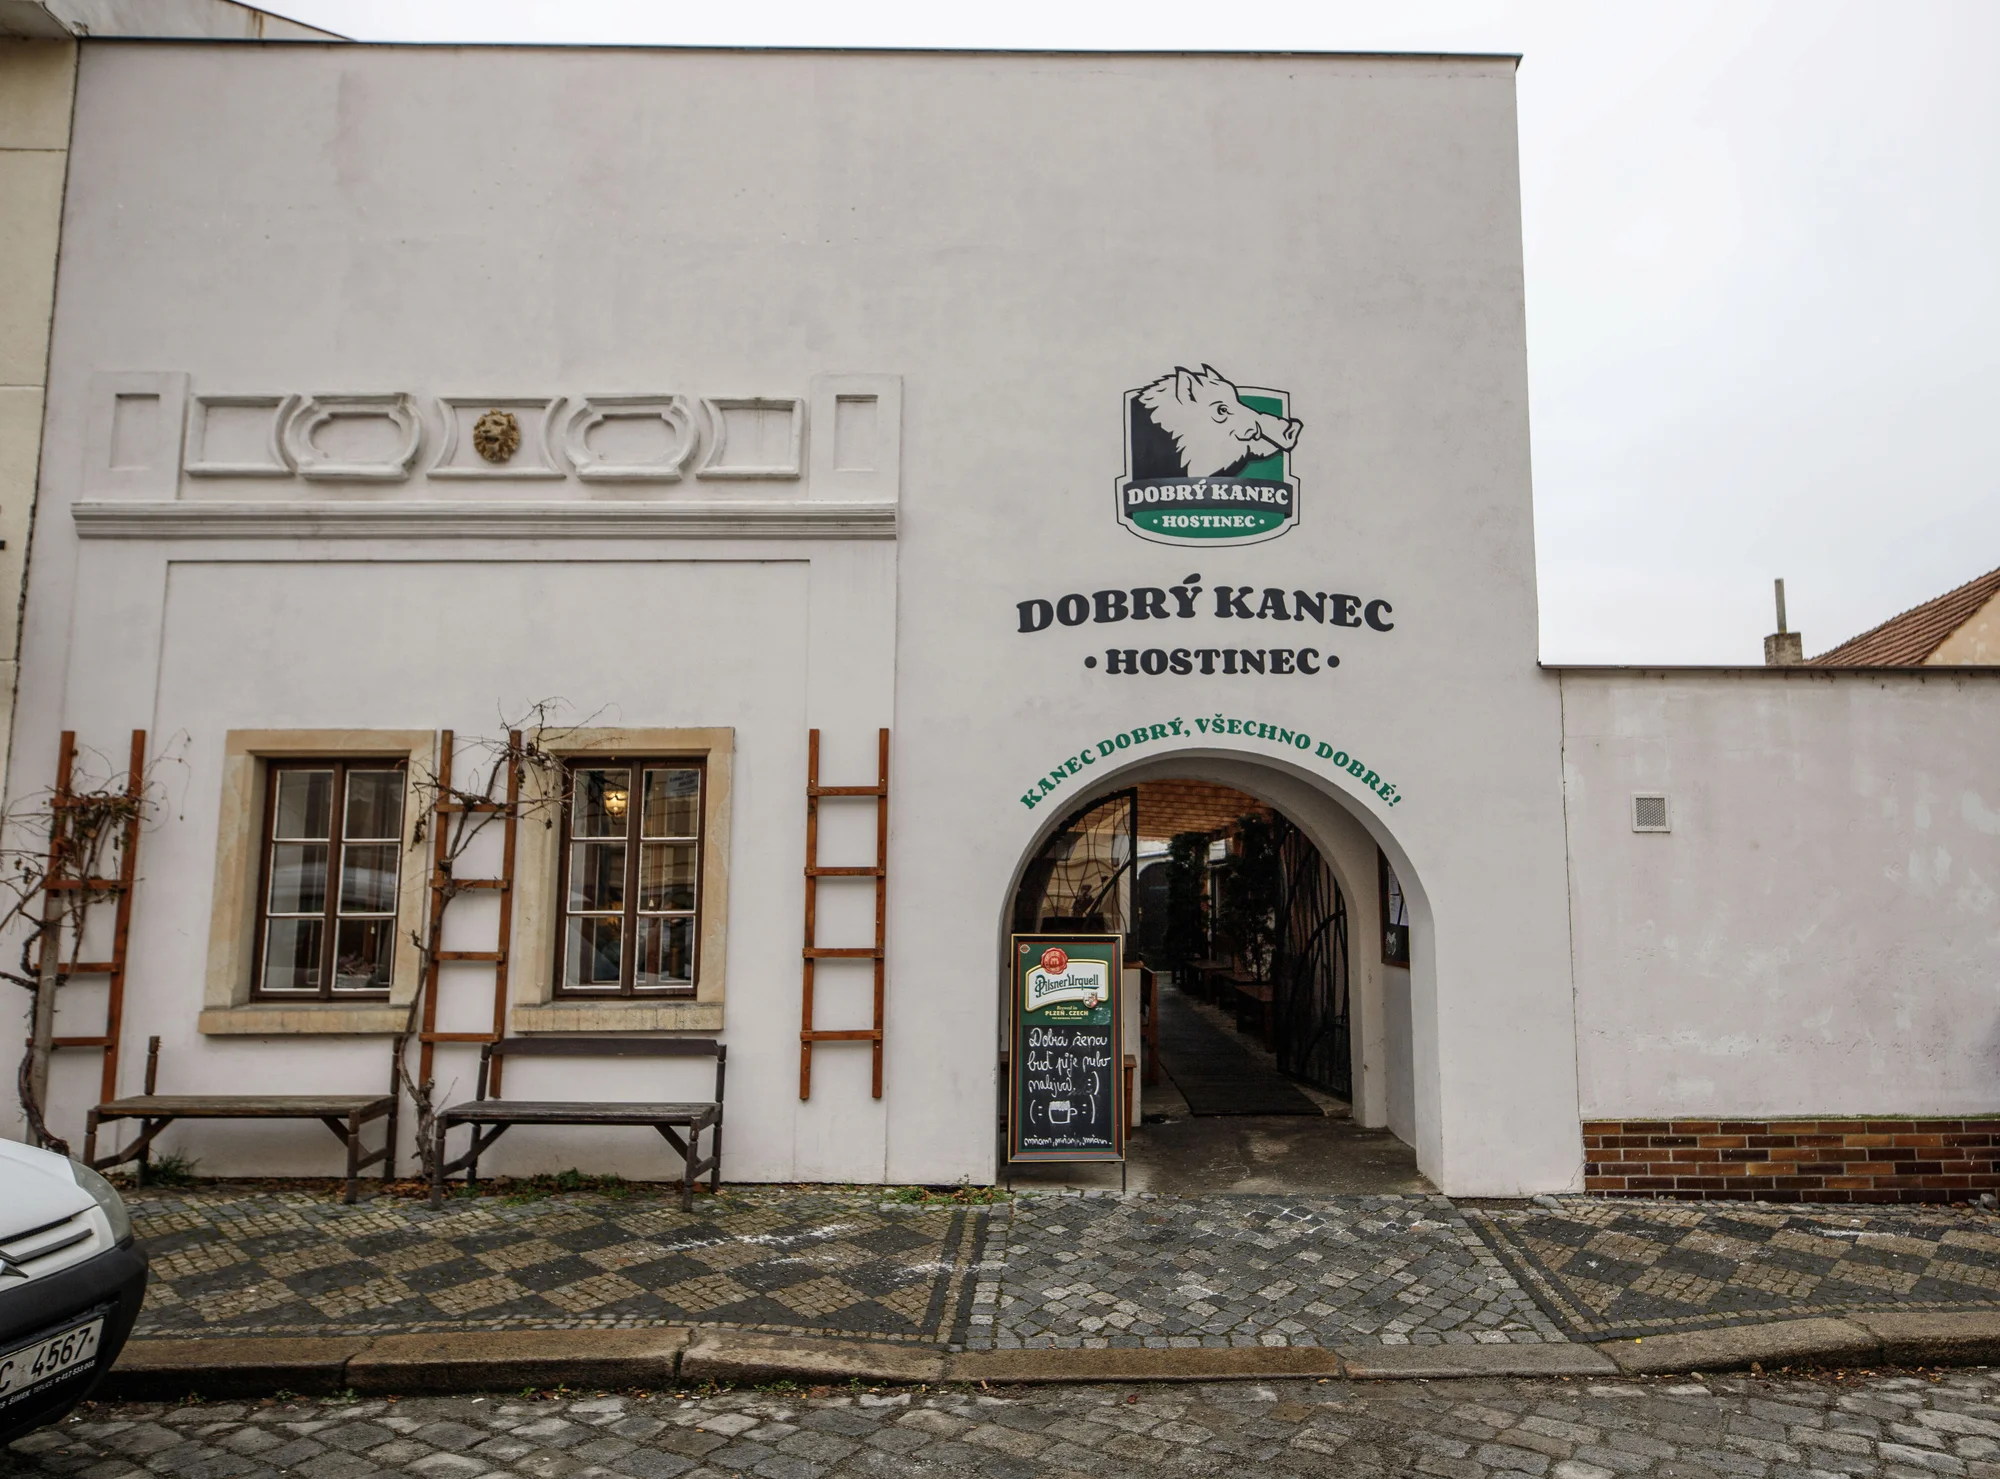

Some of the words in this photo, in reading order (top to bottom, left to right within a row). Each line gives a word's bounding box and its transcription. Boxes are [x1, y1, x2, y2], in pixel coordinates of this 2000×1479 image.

[1128, 479, 1208, 504] DOBRÝ
[1211, 484, 1289, 504] KANEC
[1162, 515, 1256, 528] HOSTINEC
[1016, 573, 1203, 633] DOBRÝ
[1213, 585, 1395, 633] KANEC
[1105, 648, 1321, 676] HOSTINEC
[1020, 749, 1097, 809] KANEC
[1096, 717, 1191, 757] DOBRÝ,
[1195, 713, 1311, 750] VŠECHNO
[1315, 741, 1402, 808] DOBRÉ!
[1034, 974, 1068, 998] Pilsner
[1067, 973, 1099, 991] Urquell
[1028, 1027, 1069, 1047] Dobrá
[1056, 1052, 1079, 1078] pije
[30, 1327, 92, 1377] 4567
